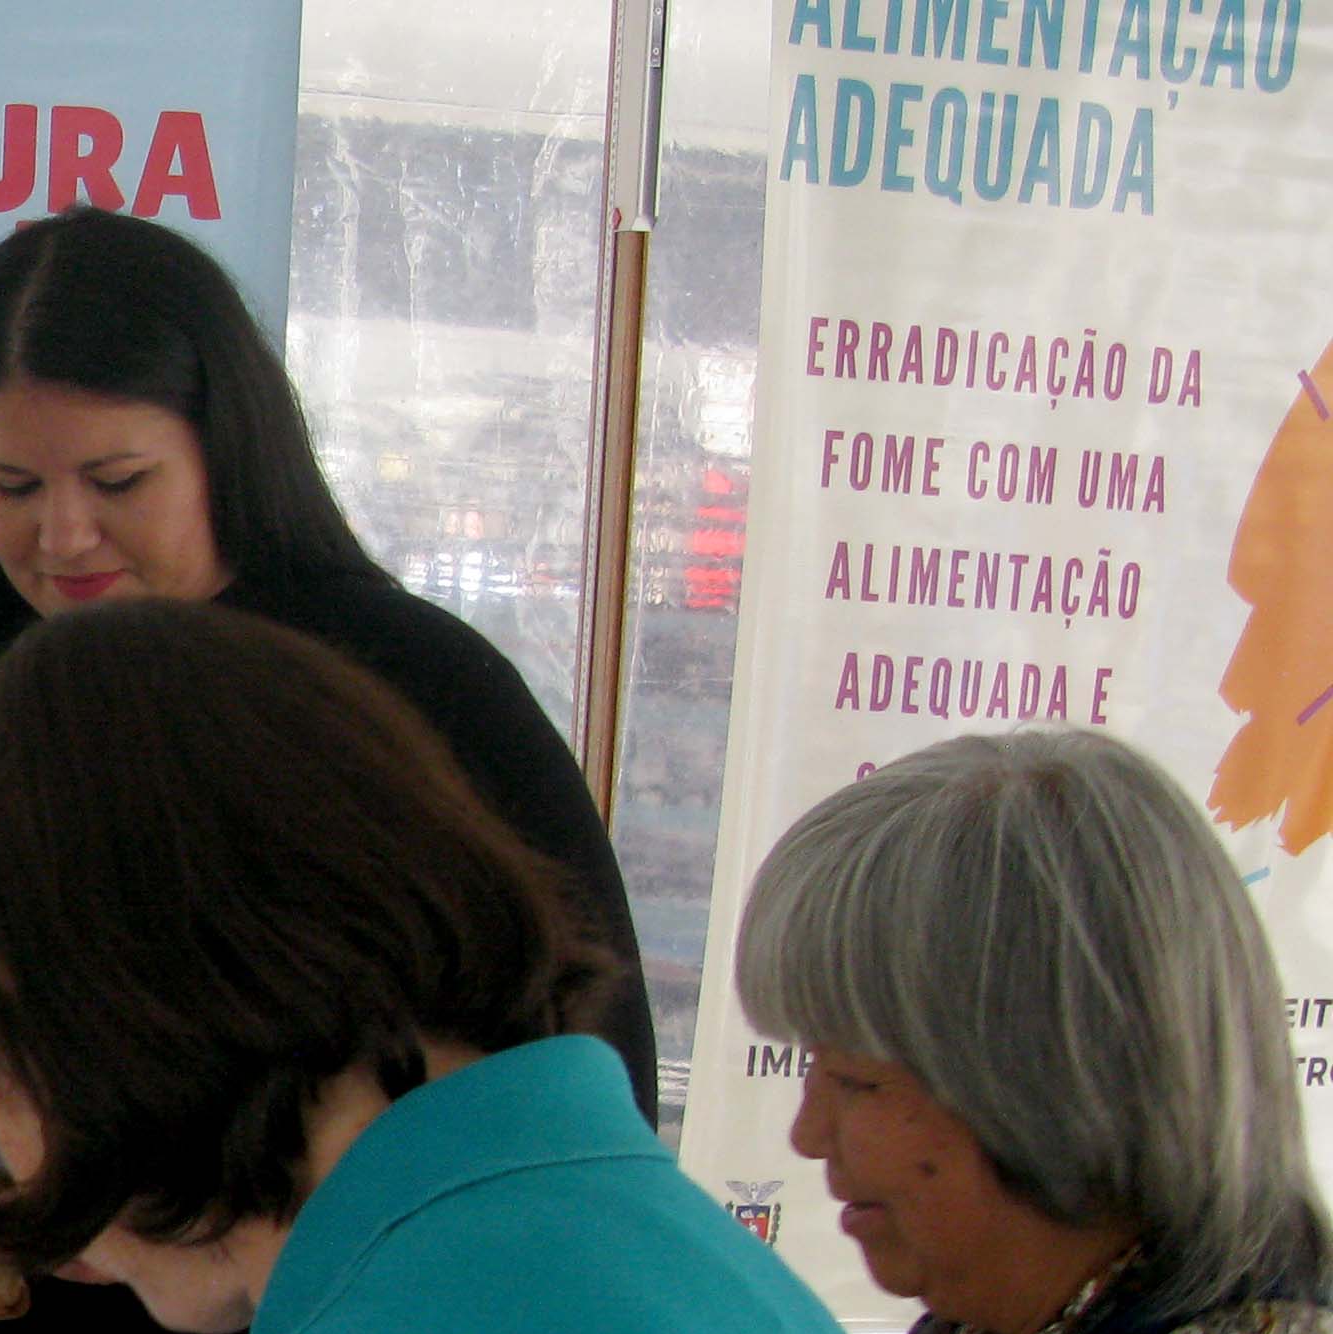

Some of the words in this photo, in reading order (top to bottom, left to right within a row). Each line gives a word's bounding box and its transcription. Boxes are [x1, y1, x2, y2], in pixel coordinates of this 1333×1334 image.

[779, 74, 1156, 216] ADEQUADA
[805, 317, 1127, 409] ERRADICAÇÃO
[1148, 346, 1202, 408] DA
[821, 429, 945, 497] FOME
[967, 441, 1058, 505] COM
[1078, 450, 1166, 513] UMA
[825, 541, 1142, 629] ALIMENTAÇÃO
[835, 652, 1068, 721] ADEQUADA
[1090, 667, 1113, 724] E
